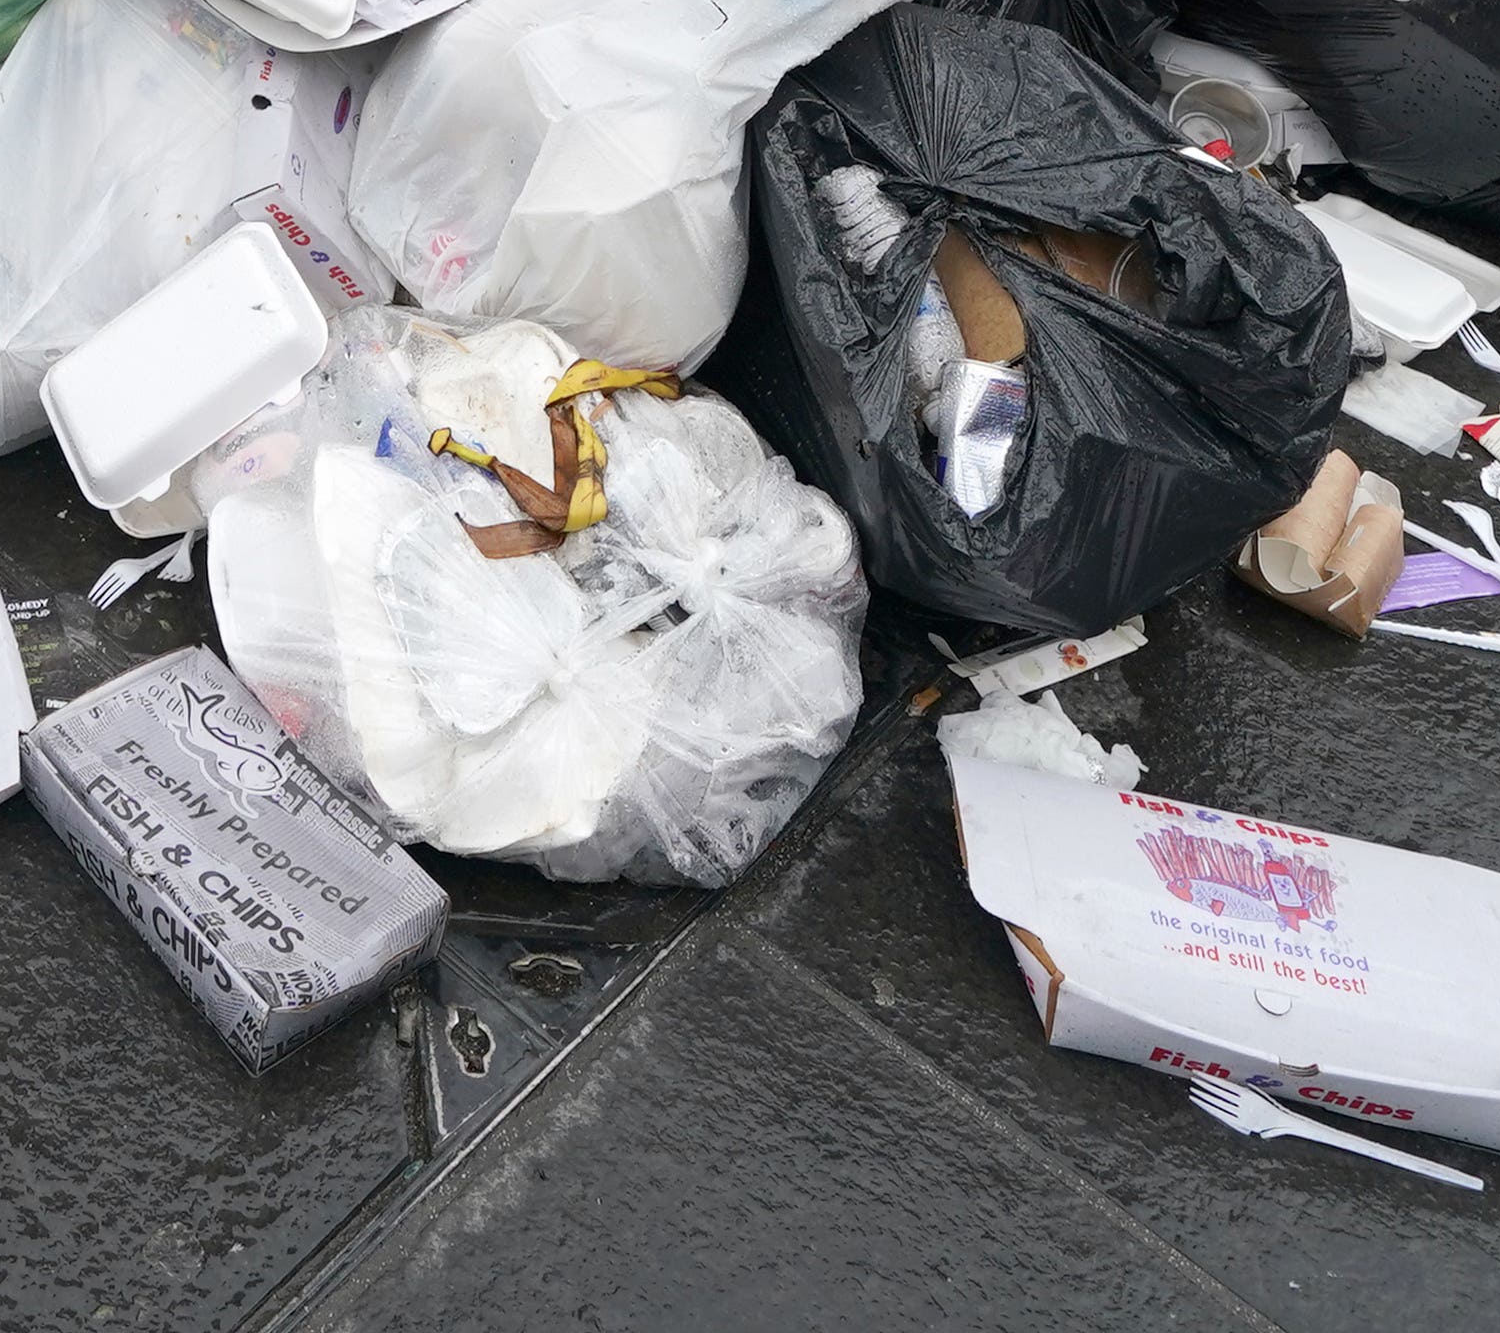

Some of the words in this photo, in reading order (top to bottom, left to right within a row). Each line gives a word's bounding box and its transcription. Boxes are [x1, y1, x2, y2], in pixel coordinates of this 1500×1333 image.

[7, 598, 50, 612] OMEDY
[9, 609, 51, 621] AND-UP
[115, 740, 219, 820] Freshly
[217, 814, 370, 916] Prepared
[325, 798, 384, 851] classic
[1118, 792, 1185, 818] Fish
[1195, 809, 1223, 824] &
[1235, 819, 1331, 849] Chips
[86, 773, 165, 842] FISH
[162, 844, 192, 869] &
[199, 869, 305, 954] CHIPS
[151, 905, 233, 993] CHIPS
[1150, 910, 1181, 931] the
[1191, 921, 1267, 949] original
[1274, 937, 1313, 961] fast
[1320, 947, 1371, 973] food
[1229, 953, 1266, 973] still
[1273, 960, 1307, 983] the
[1314, 969, 1369, 996] best!
[1149, 1046, 1232, 1079] Fish
